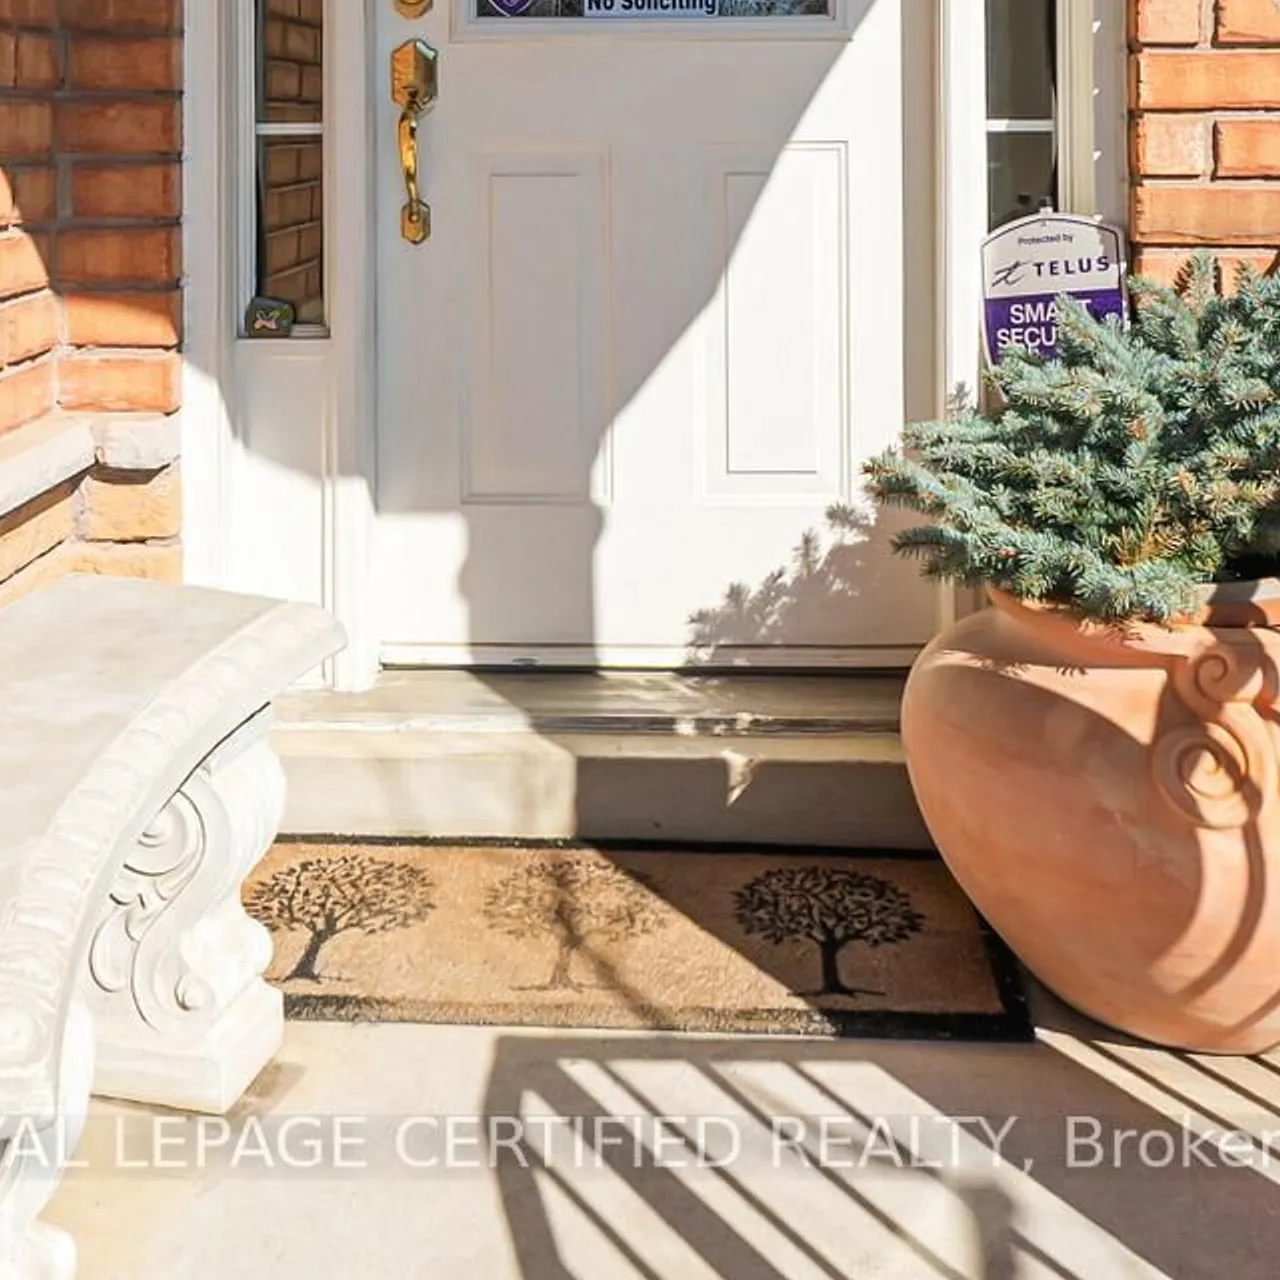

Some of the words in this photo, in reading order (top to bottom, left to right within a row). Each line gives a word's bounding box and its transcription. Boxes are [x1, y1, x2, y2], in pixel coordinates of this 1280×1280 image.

[1018, 234, 1061, 245] Protected
[1062, 233, 1073, 242] by
[1033, 256, 1110, 276] TELUS
[1009, 299, 1092, 324] SMAT
